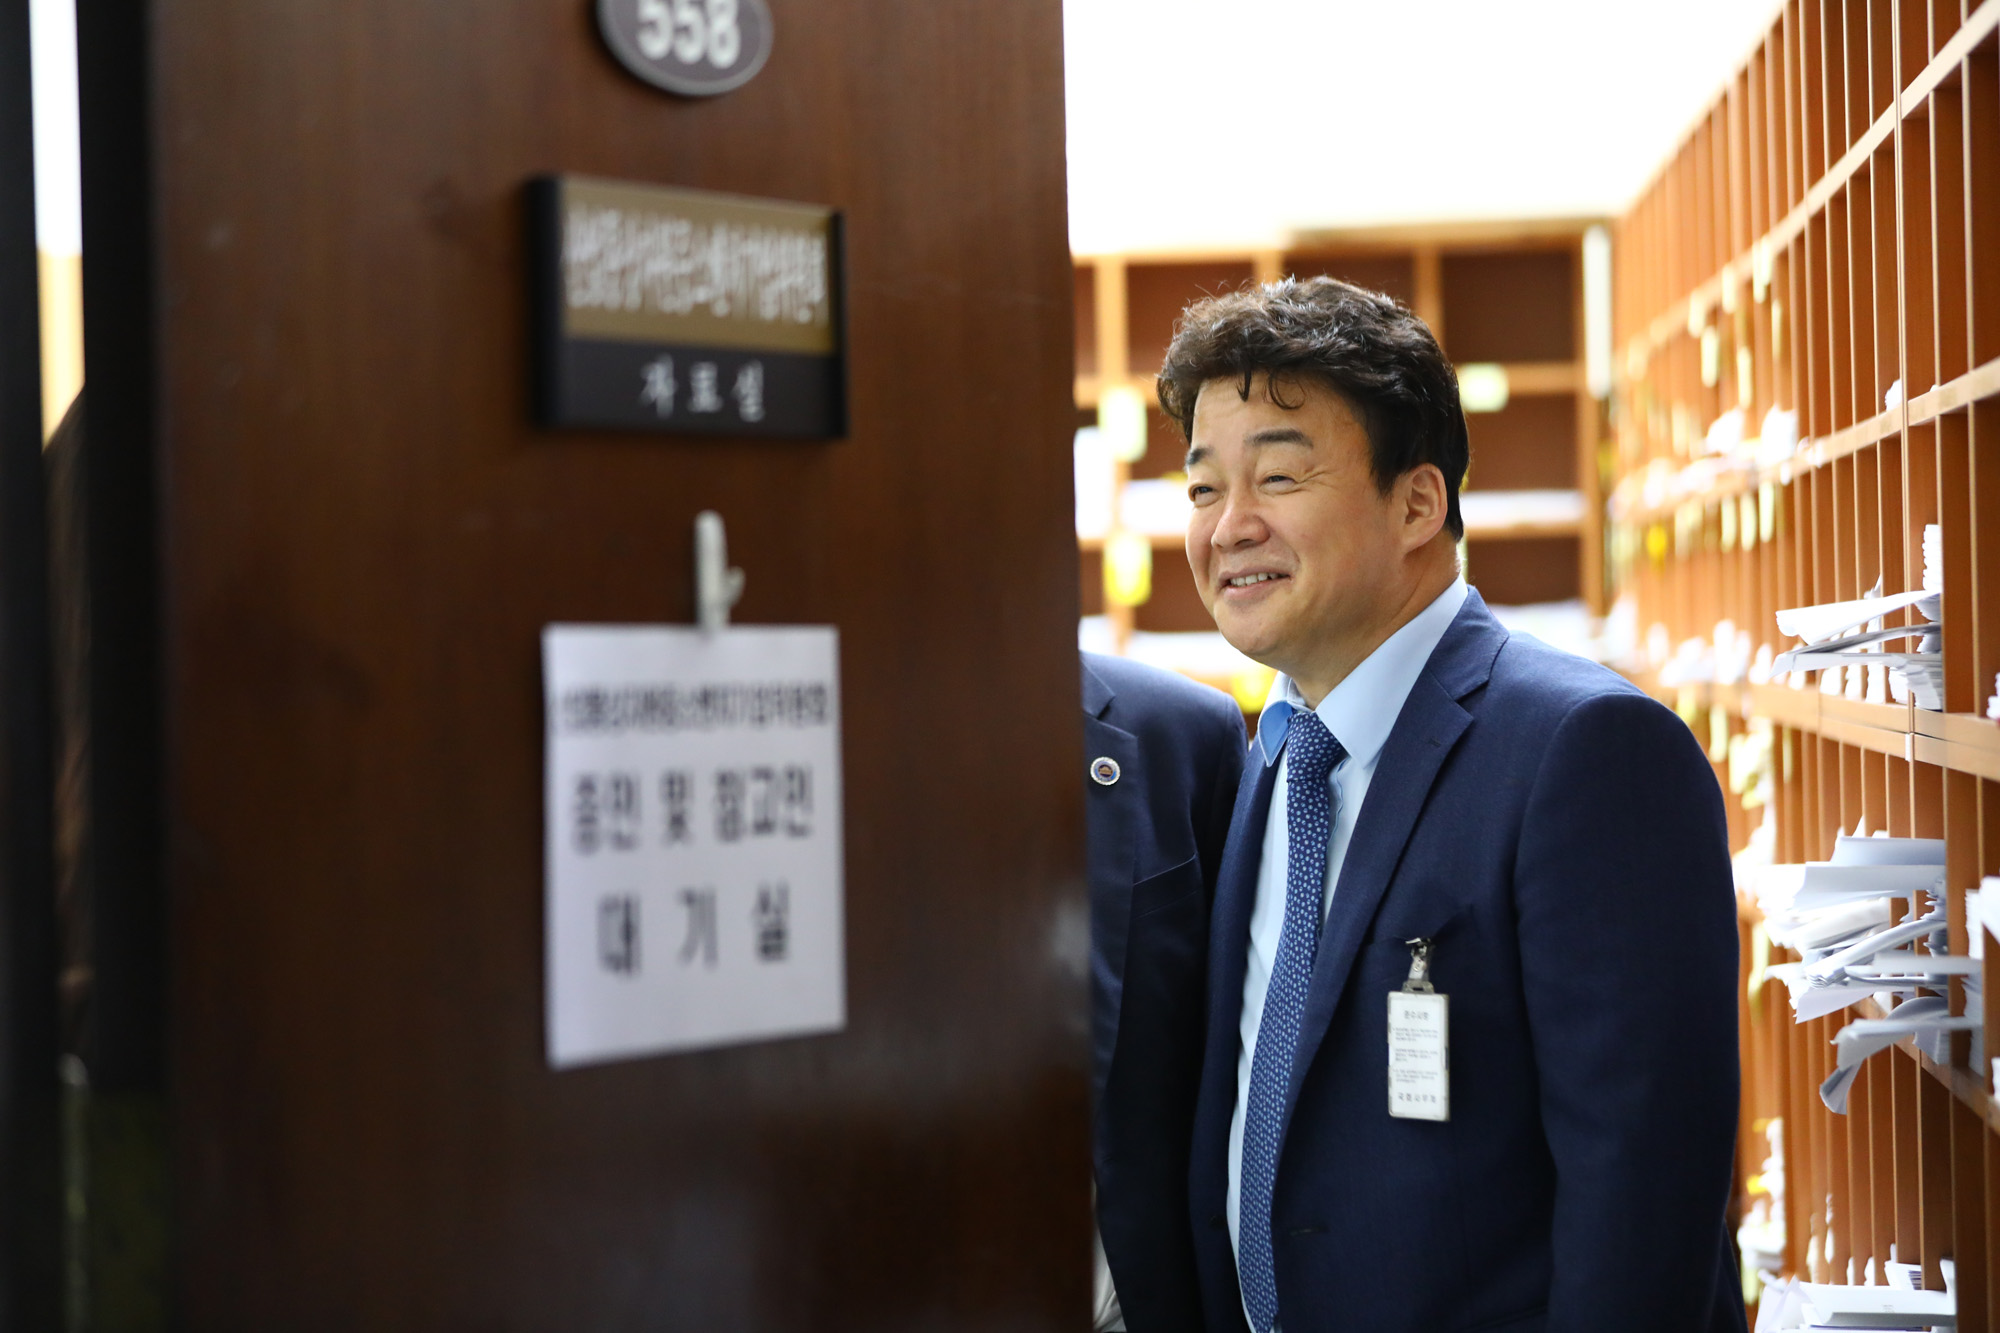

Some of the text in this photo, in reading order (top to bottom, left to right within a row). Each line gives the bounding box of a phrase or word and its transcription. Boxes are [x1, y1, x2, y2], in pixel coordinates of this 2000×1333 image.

[638, 0, 740, 67] 558
[572, 764, 813, 855] 증인 및 참고인
